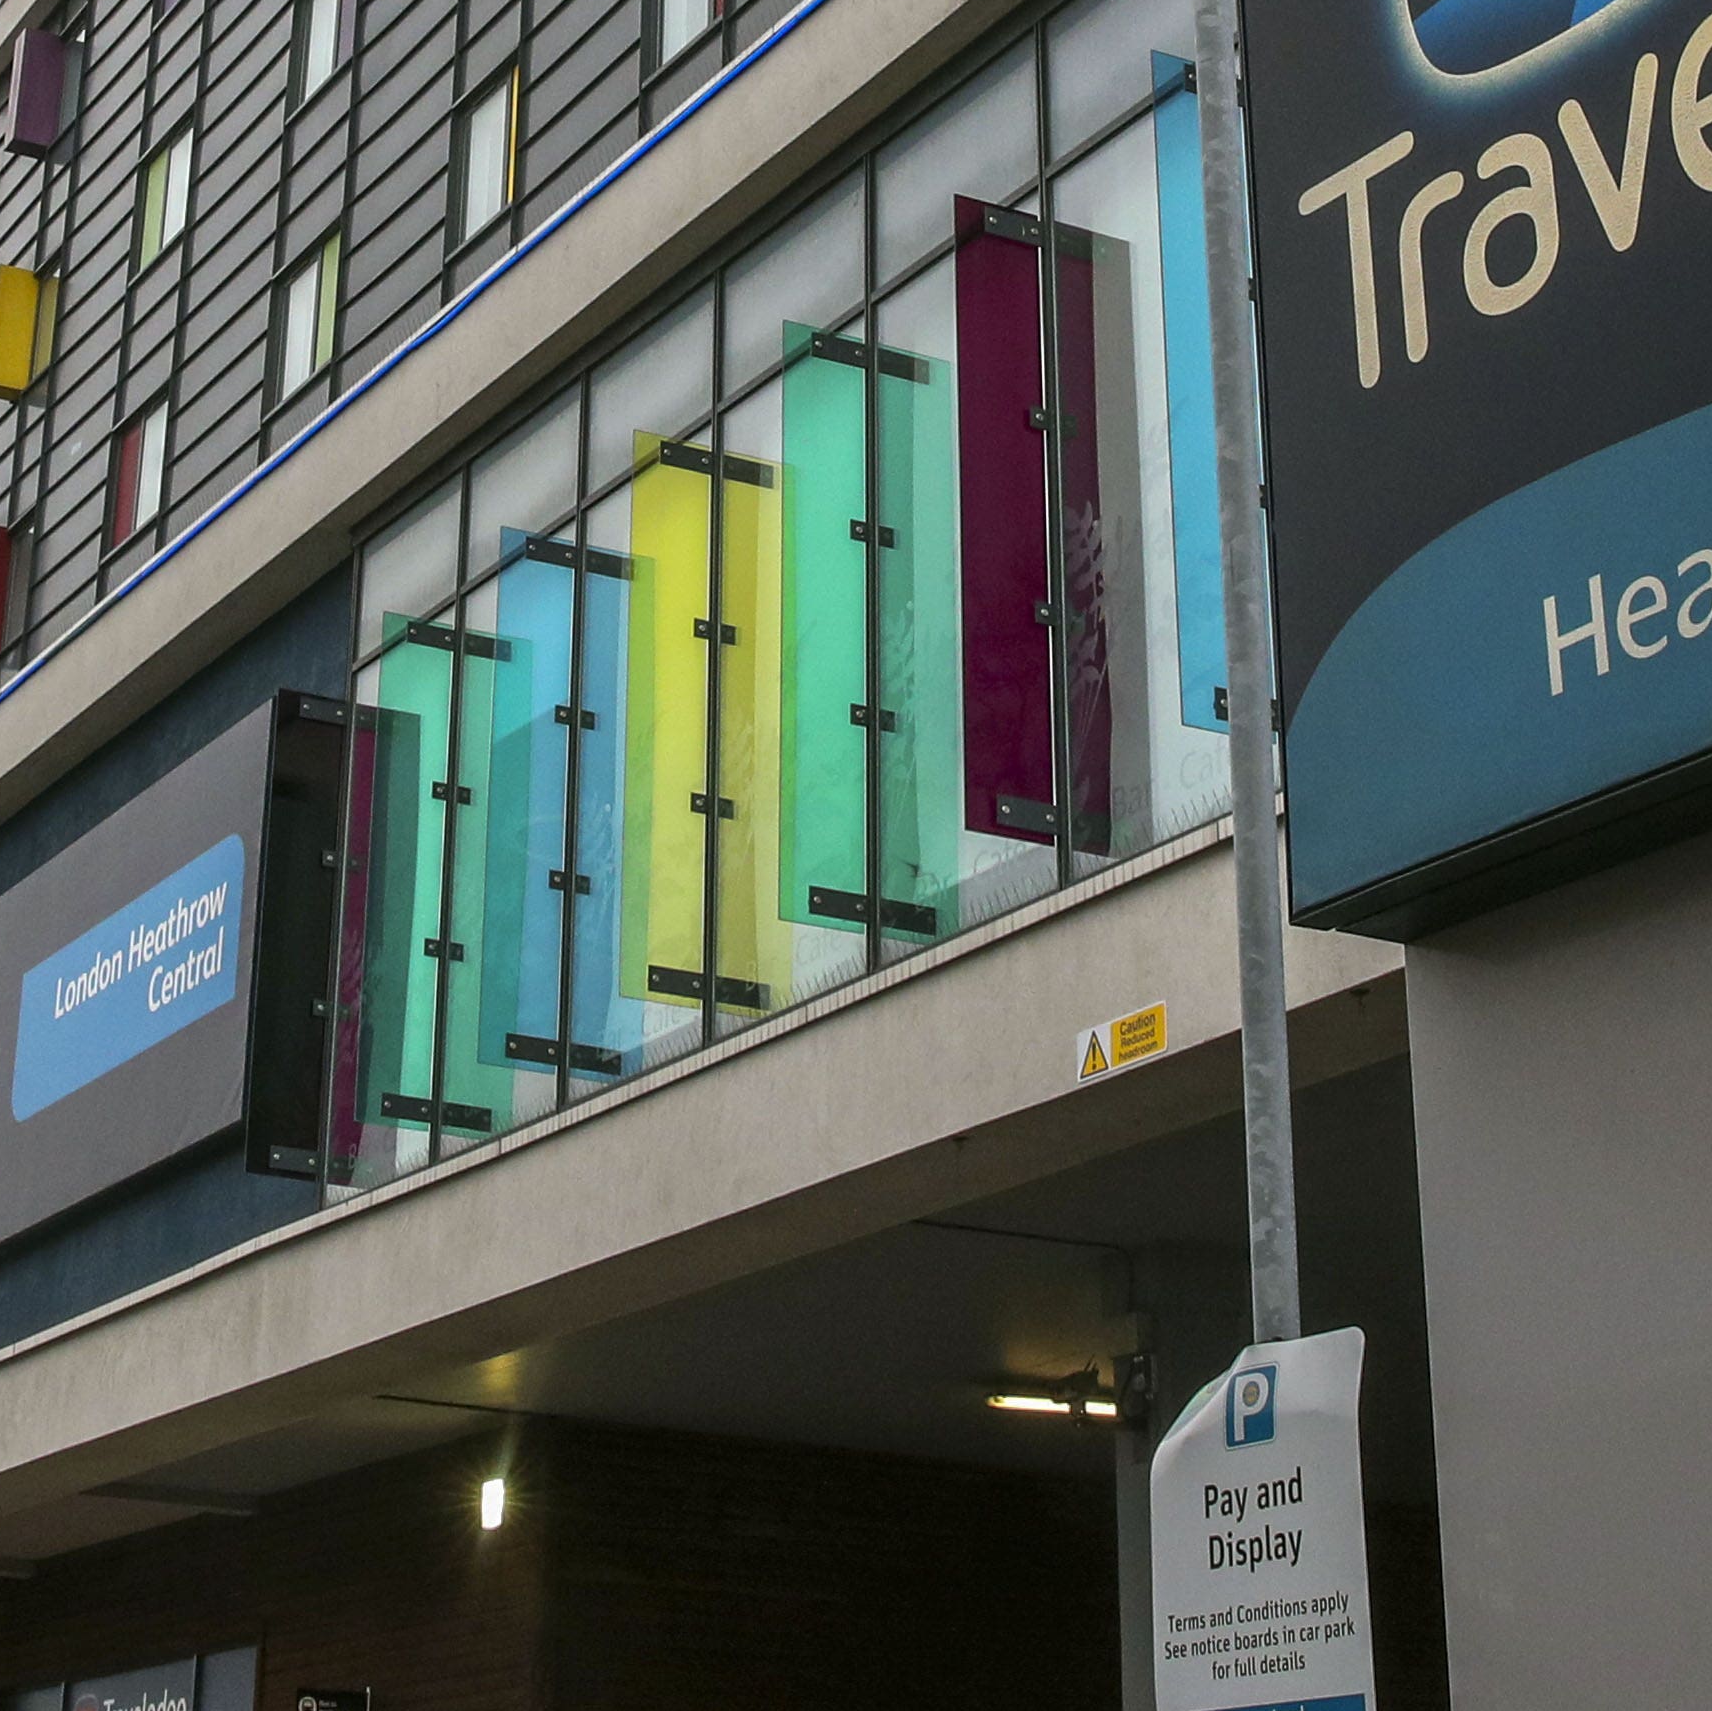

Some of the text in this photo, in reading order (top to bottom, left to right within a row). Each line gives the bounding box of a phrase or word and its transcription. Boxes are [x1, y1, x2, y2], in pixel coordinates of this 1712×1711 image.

[54, 878, 229, 1020] London Heathrow
[147, 926, 225, 1013] Central
[1120, 1013, 1156, 1036] Caution
[1121, 1026, 1155, 1048] Reduced
[1119, 1040, 1158, 1063] headroom
[1204, 1466, 1303, 1523] Pay and
[1208, 1525, 1303, 1573] Display
[1167, 1591, 1349, 1634] Terms and Conditions apply
[1165, 1618, 1355, 1660] See notice boards in car park
[1211, 1651, 1306, 1681] for full details
